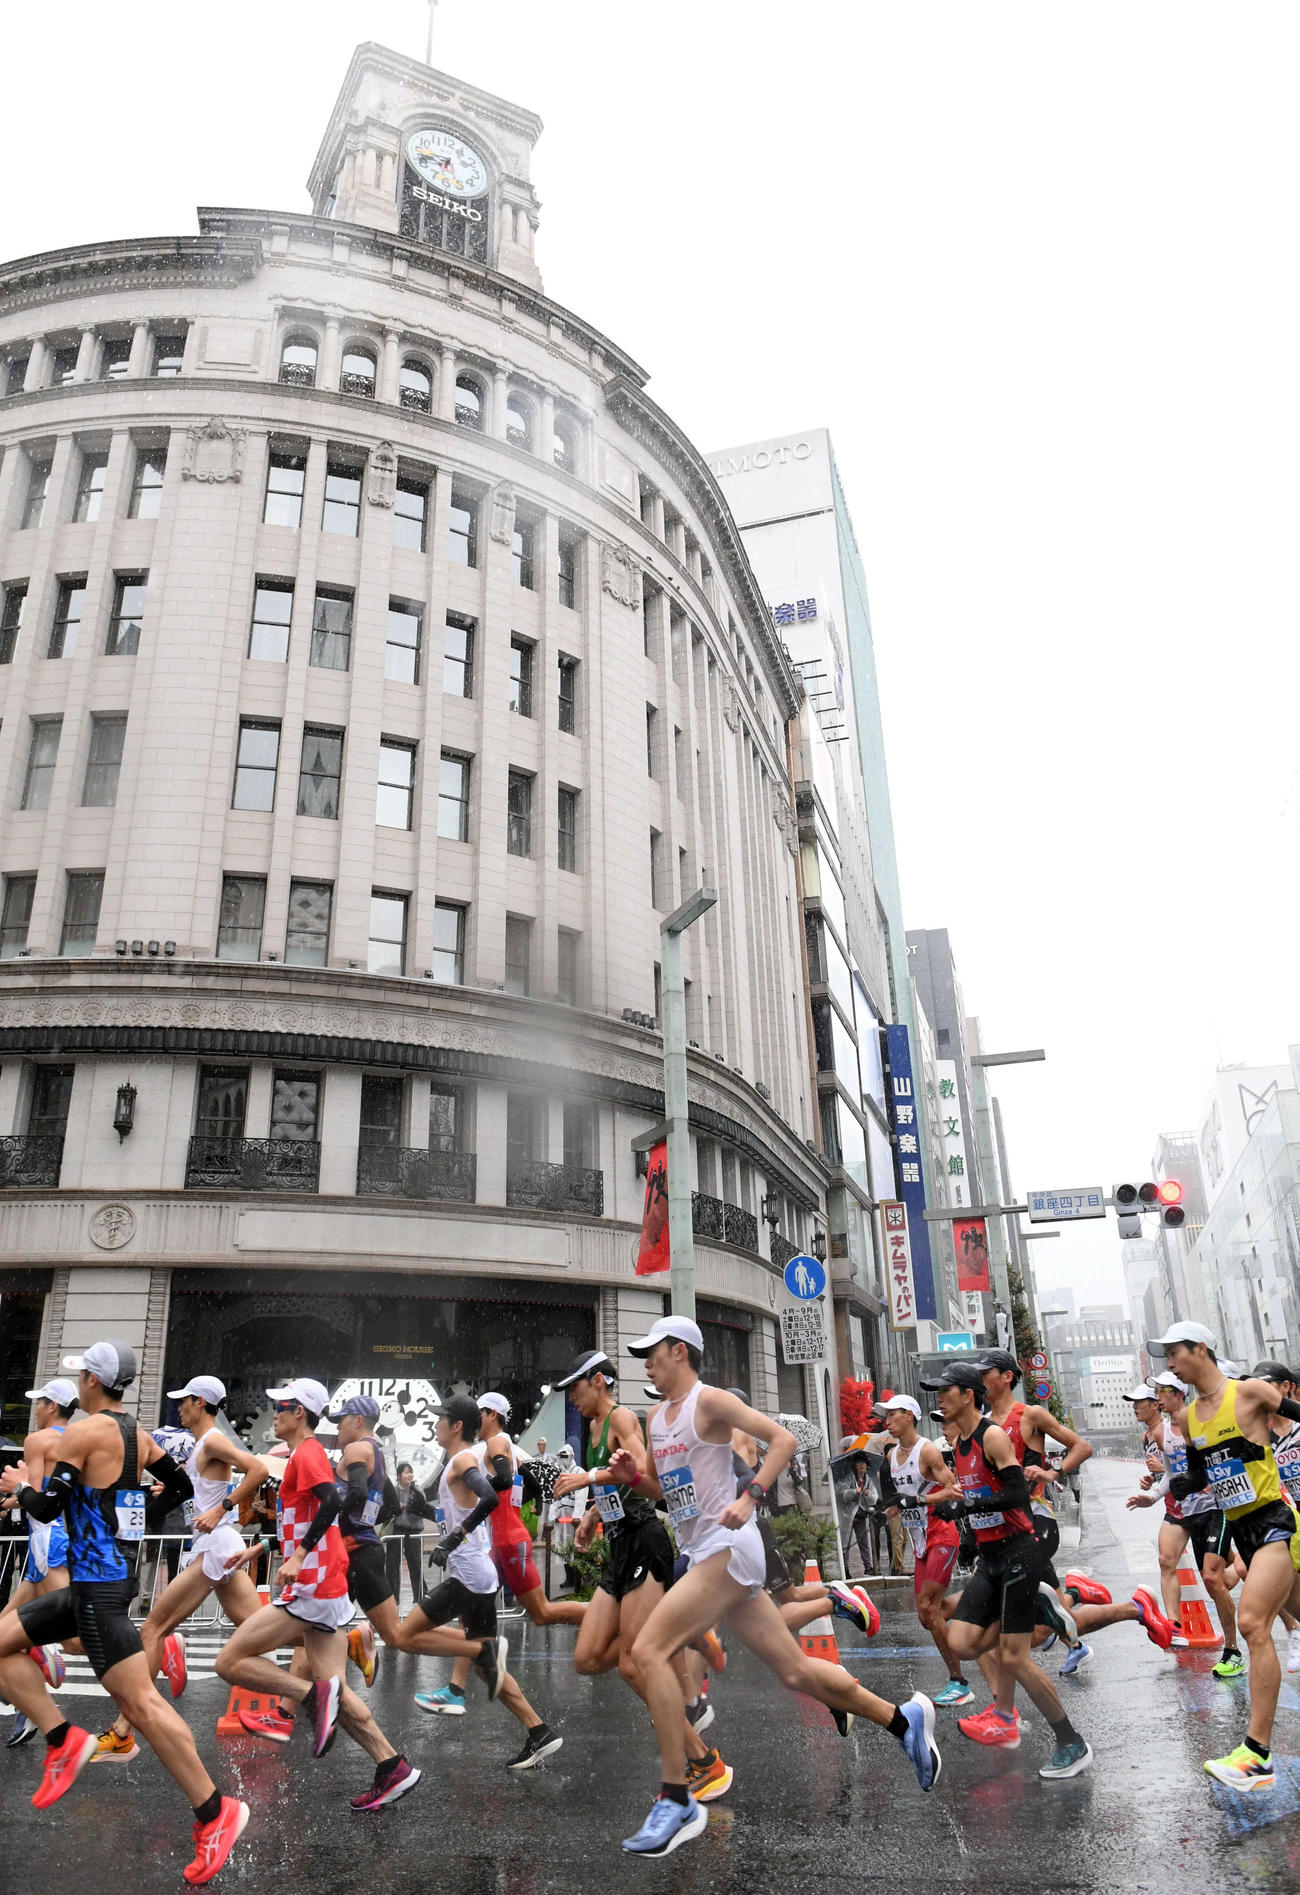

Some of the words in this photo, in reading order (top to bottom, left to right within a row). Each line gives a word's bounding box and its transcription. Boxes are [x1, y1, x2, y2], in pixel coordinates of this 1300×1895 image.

[412, 185, 482, 222] SEIKO
[710, 443, 812, 478] IMOTO
[769, 598, 817, 624] 楽器
[893, 1077, 921, 1182] 山野楽器
[938, 1078, 965, 1176] 教文館
[1033, 1194, 1100, 1210] 銀座四丁目
[1053, 1209, 1073, 1217] Ginza
[1075, 1208, 1080, 1216] 4
[889, 1235, 913, 1321] キムラヤのパン
[372, 1345, 402, 1353] SEIKO
[403, 1345, 434, 1353] HOUSE
[360, 1381, 373, 1397] 11
[378, 1379, 396, 1397] 12
[416, 1397, 429, 1418] 2
[421, 1421, 436, 1442] 3
[664, 1474, 680, 1489] Sky
[1214, 1466, 1232, 1477] Sky
